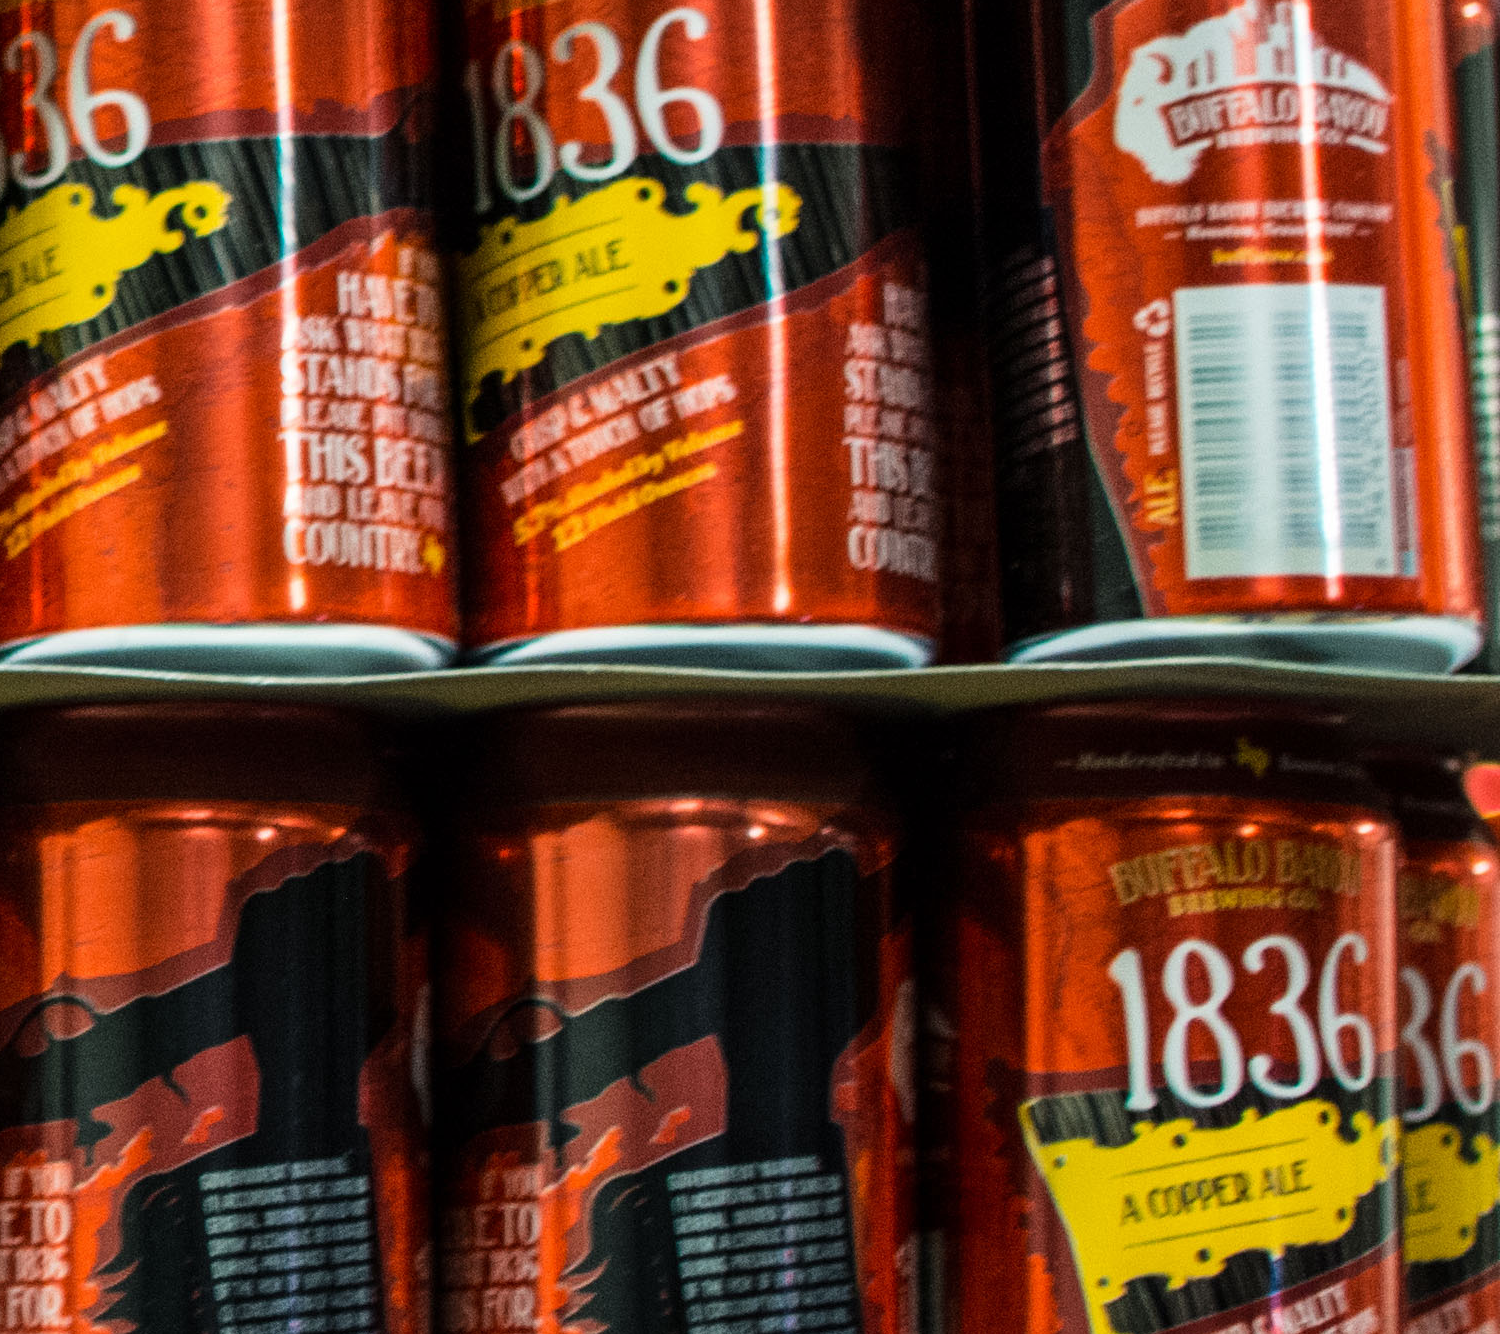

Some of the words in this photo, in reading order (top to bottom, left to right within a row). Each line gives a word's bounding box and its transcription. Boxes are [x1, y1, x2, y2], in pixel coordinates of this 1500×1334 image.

[469, 9, 722, 214] 1836
[1172, 93, 1294, 141] BUFFALO
[1302, 89, 1388, 135] BAYOU
[572, 240, 629, 277] ALE
[280, 431, 367, 477] THIS
[1112, 846, 1264, 904] BUFFALO
[1109, 932, 1377, 1112] 1836
[1148, 1174, 1251, 1218] COPPER
[1259, 1161, 1311, 1198] ALE
